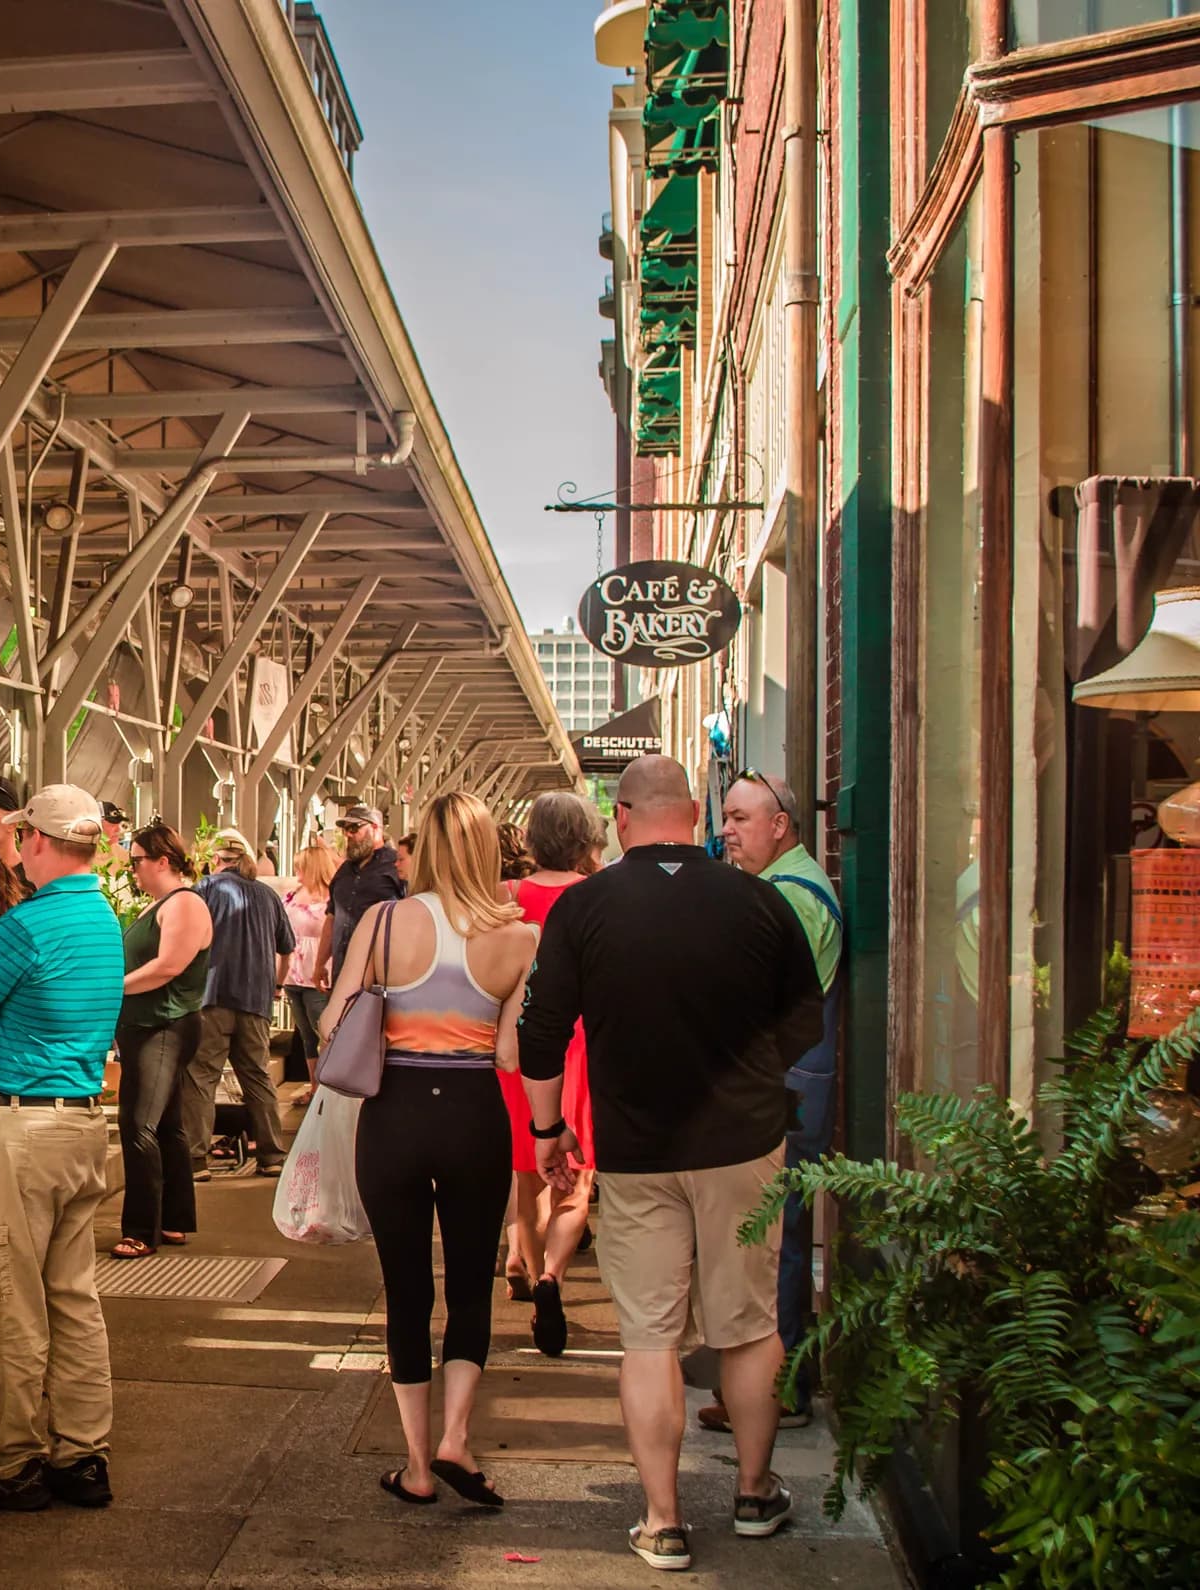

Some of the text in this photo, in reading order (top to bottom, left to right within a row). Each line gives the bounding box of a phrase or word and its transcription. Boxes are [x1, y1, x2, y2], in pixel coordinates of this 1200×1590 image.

[686, 579, 717, 606] &
[601, 606, 722, 658] BAKERY
[583, 736, 662, 749] DESCHUTES
